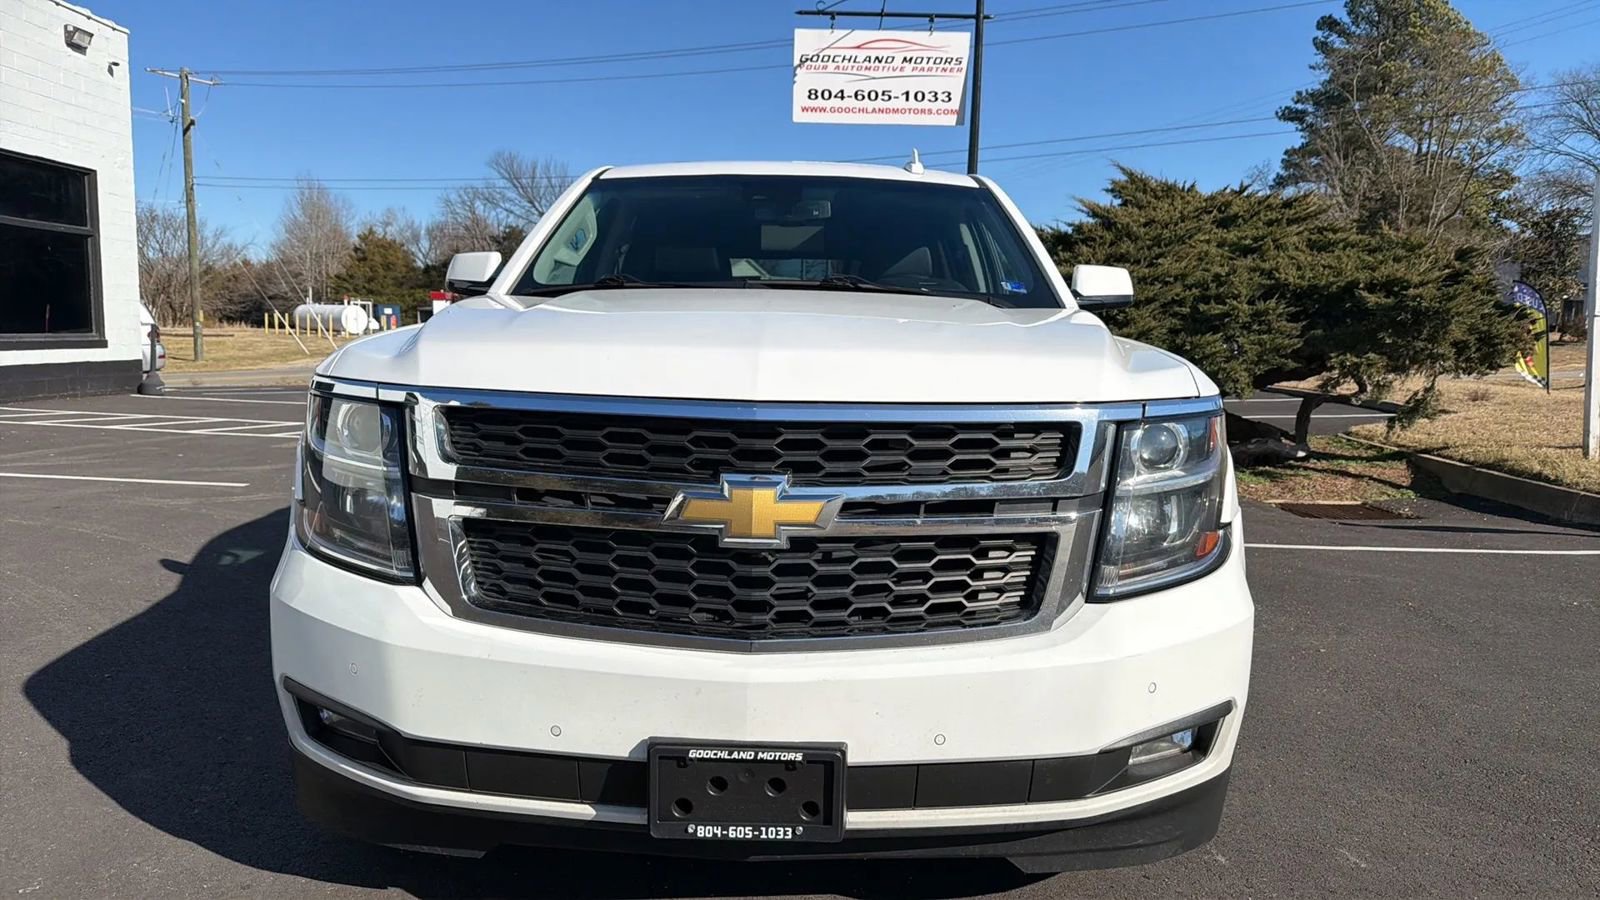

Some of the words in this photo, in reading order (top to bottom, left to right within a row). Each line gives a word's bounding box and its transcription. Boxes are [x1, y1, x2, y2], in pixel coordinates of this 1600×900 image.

[799, 54, 895, 65] GOOCHLAND
[901, 56, 963, 66] MOTORS
[834, 65, 905, 73] AUTOMOTIVE
[807, 88, 953, 103] 804-605-1033
[800, 105, 960, 116] WWW.GOOCHLANDMOTORS.COM
[689, 749, 755, 760] GOOCHLAND
[757, 752, 803, 761] MOTORS
[697, 825, 793, 839] 804-605-1033
